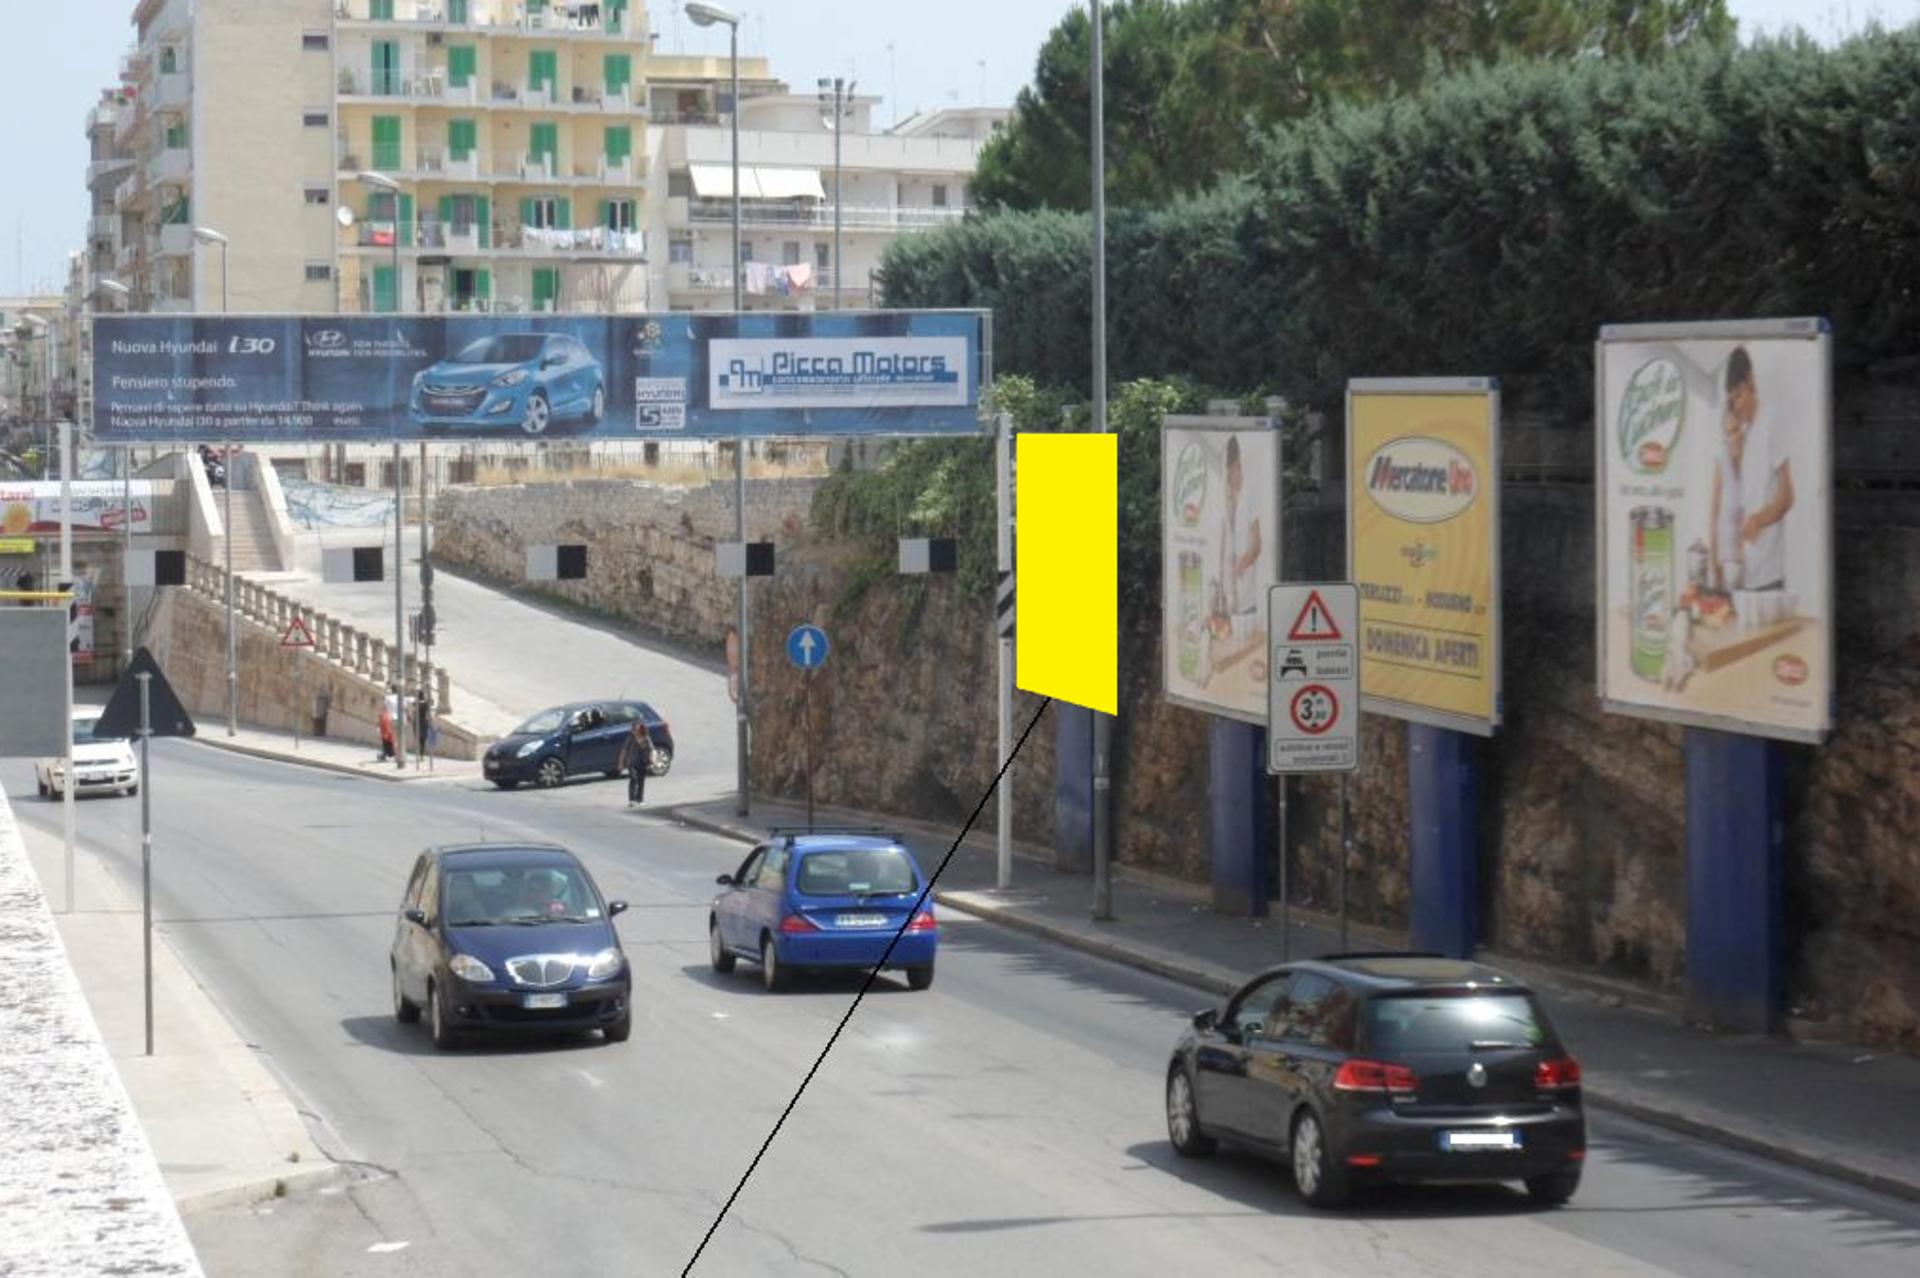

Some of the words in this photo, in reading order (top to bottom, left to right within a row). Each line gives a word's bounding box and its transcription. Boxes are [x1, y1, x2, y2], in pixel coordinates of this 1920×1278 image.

[112, 340, 157, 354] Nuova
[160, 340, 218, 357] Hyundai
[229, 335, 275, 354] i30
[853, 351, 946, 375] Motors
